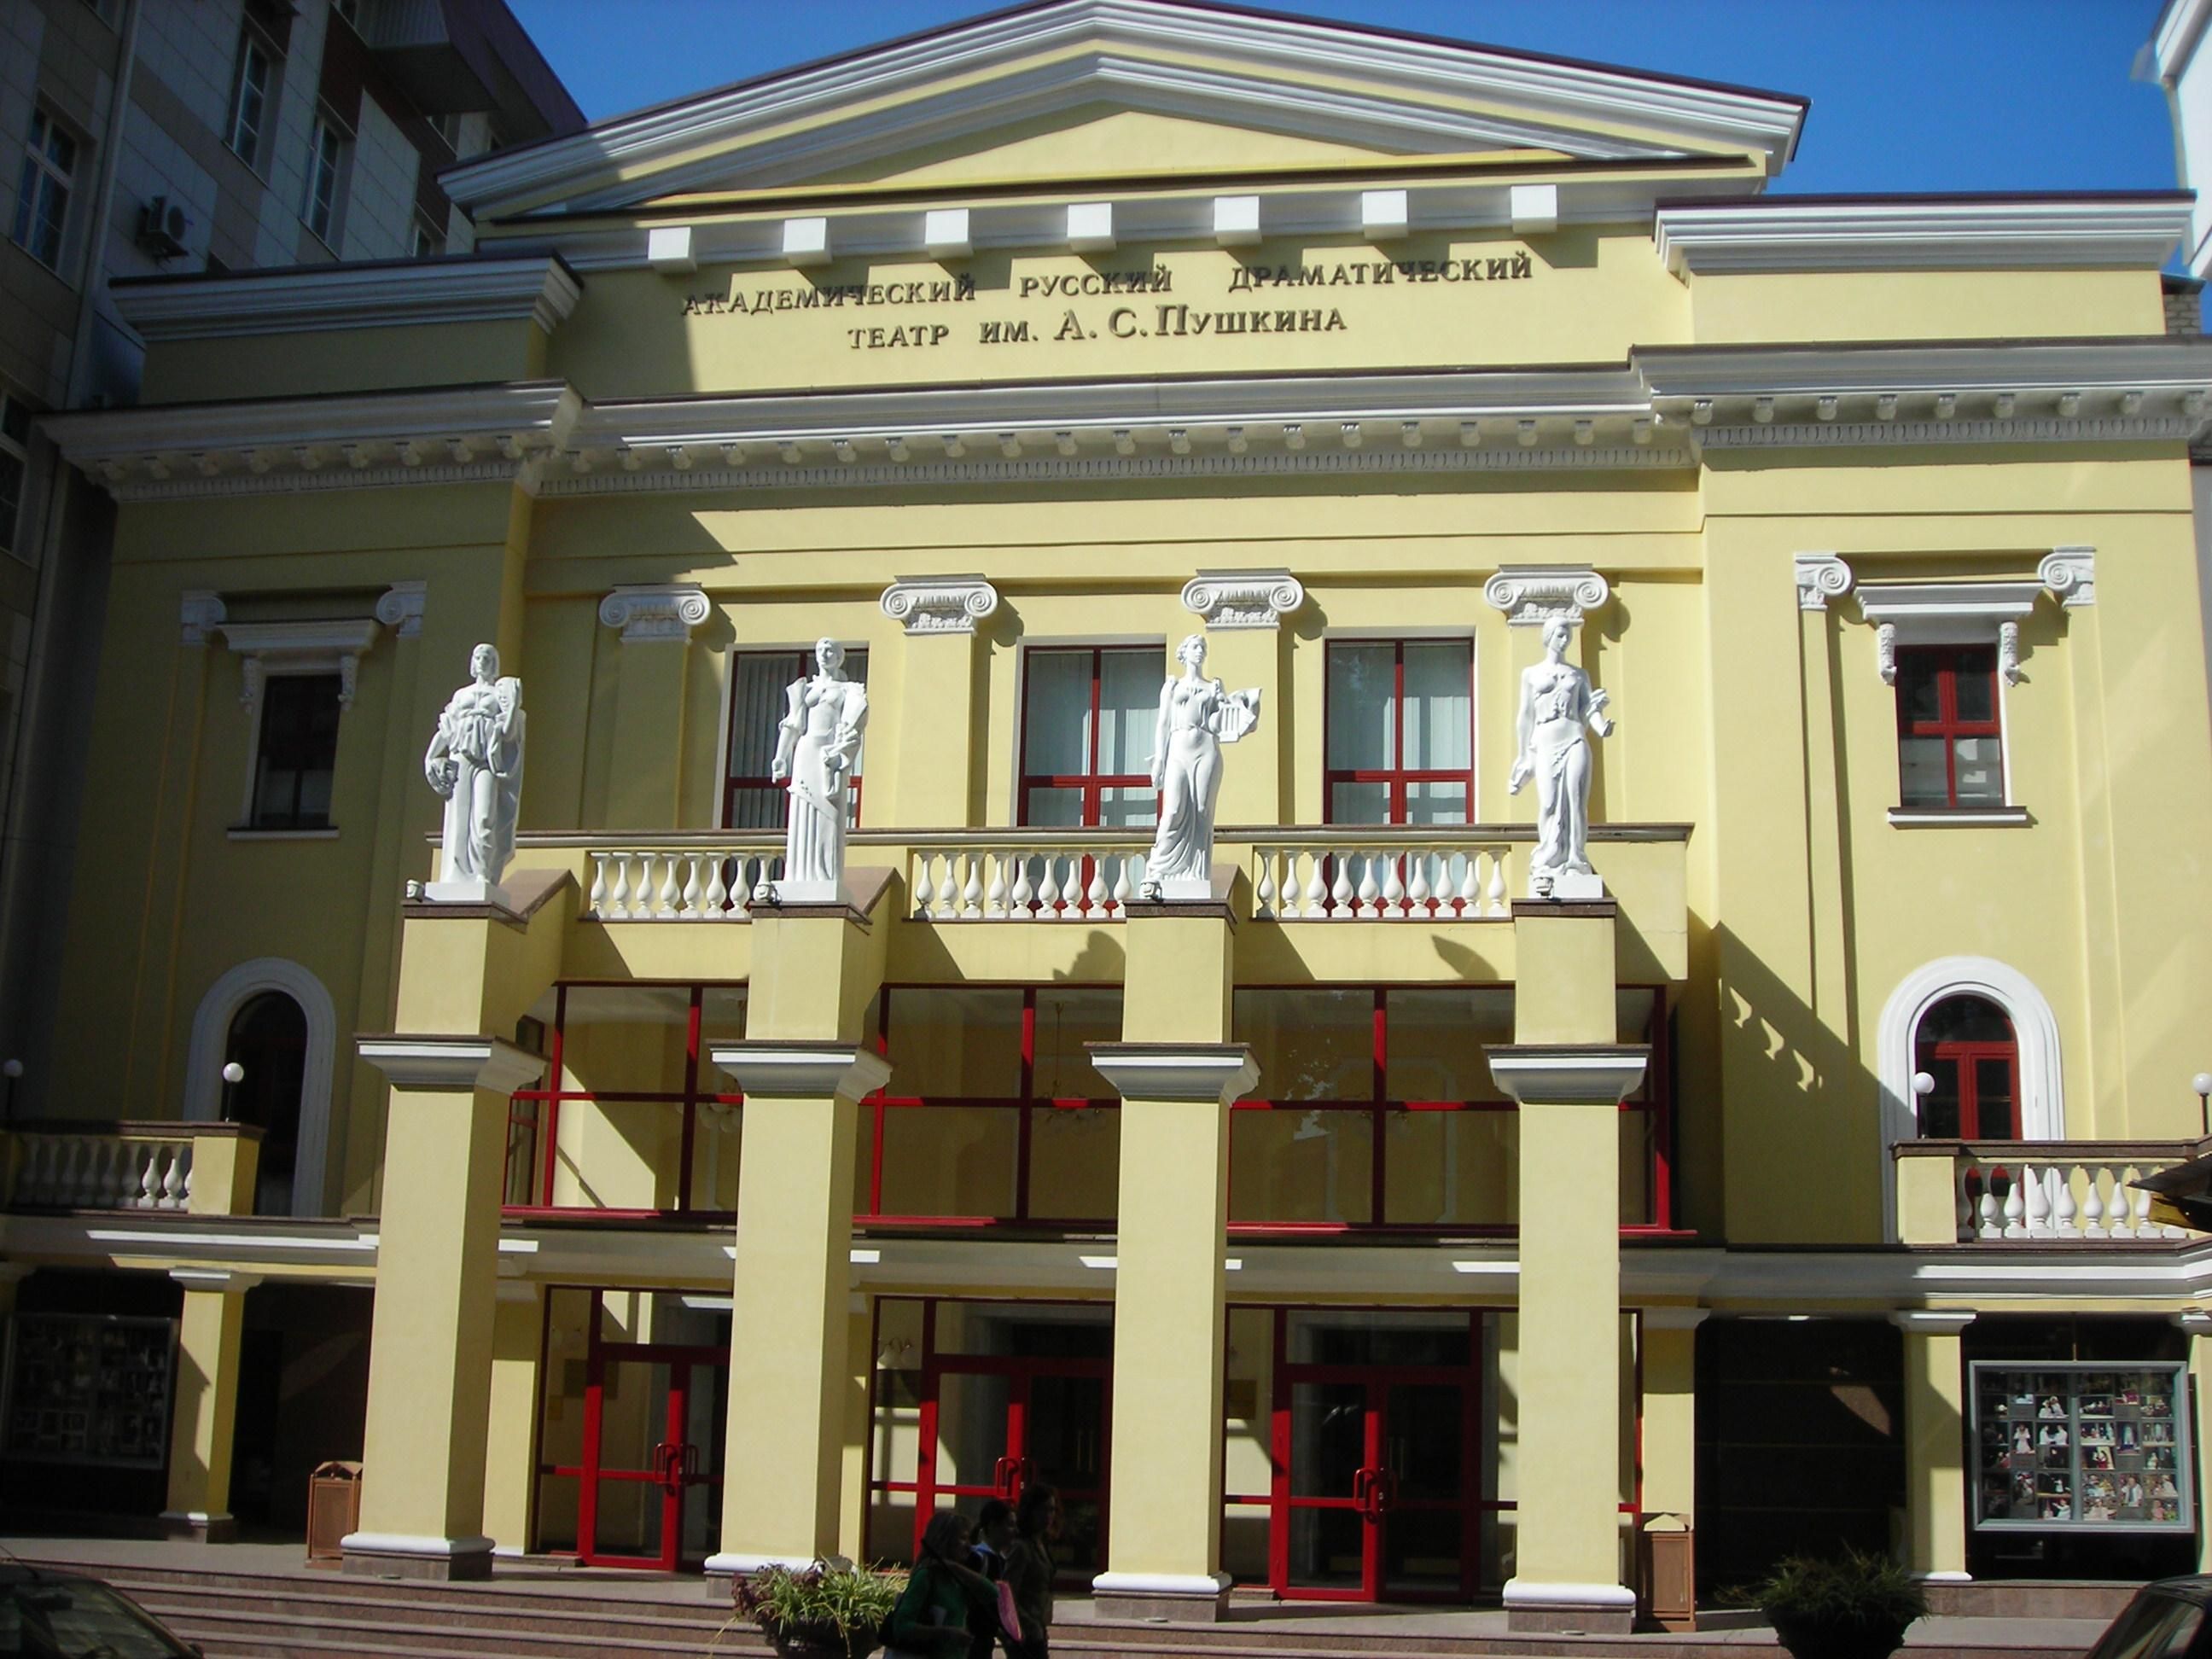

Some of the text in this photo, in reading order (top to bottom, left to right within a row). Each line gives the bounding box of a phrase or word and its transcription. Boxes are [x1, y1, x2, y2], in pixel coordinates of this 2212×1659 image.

[682, 251, 1533, 316] АКАДЕМИЧЕСКИЙ РУССКИЙ ДРАМАТИЧЕСКИЙ
[847, 324, 949, 349] ТЕАТР
[979, 320, 1039, 343] ИМ.
